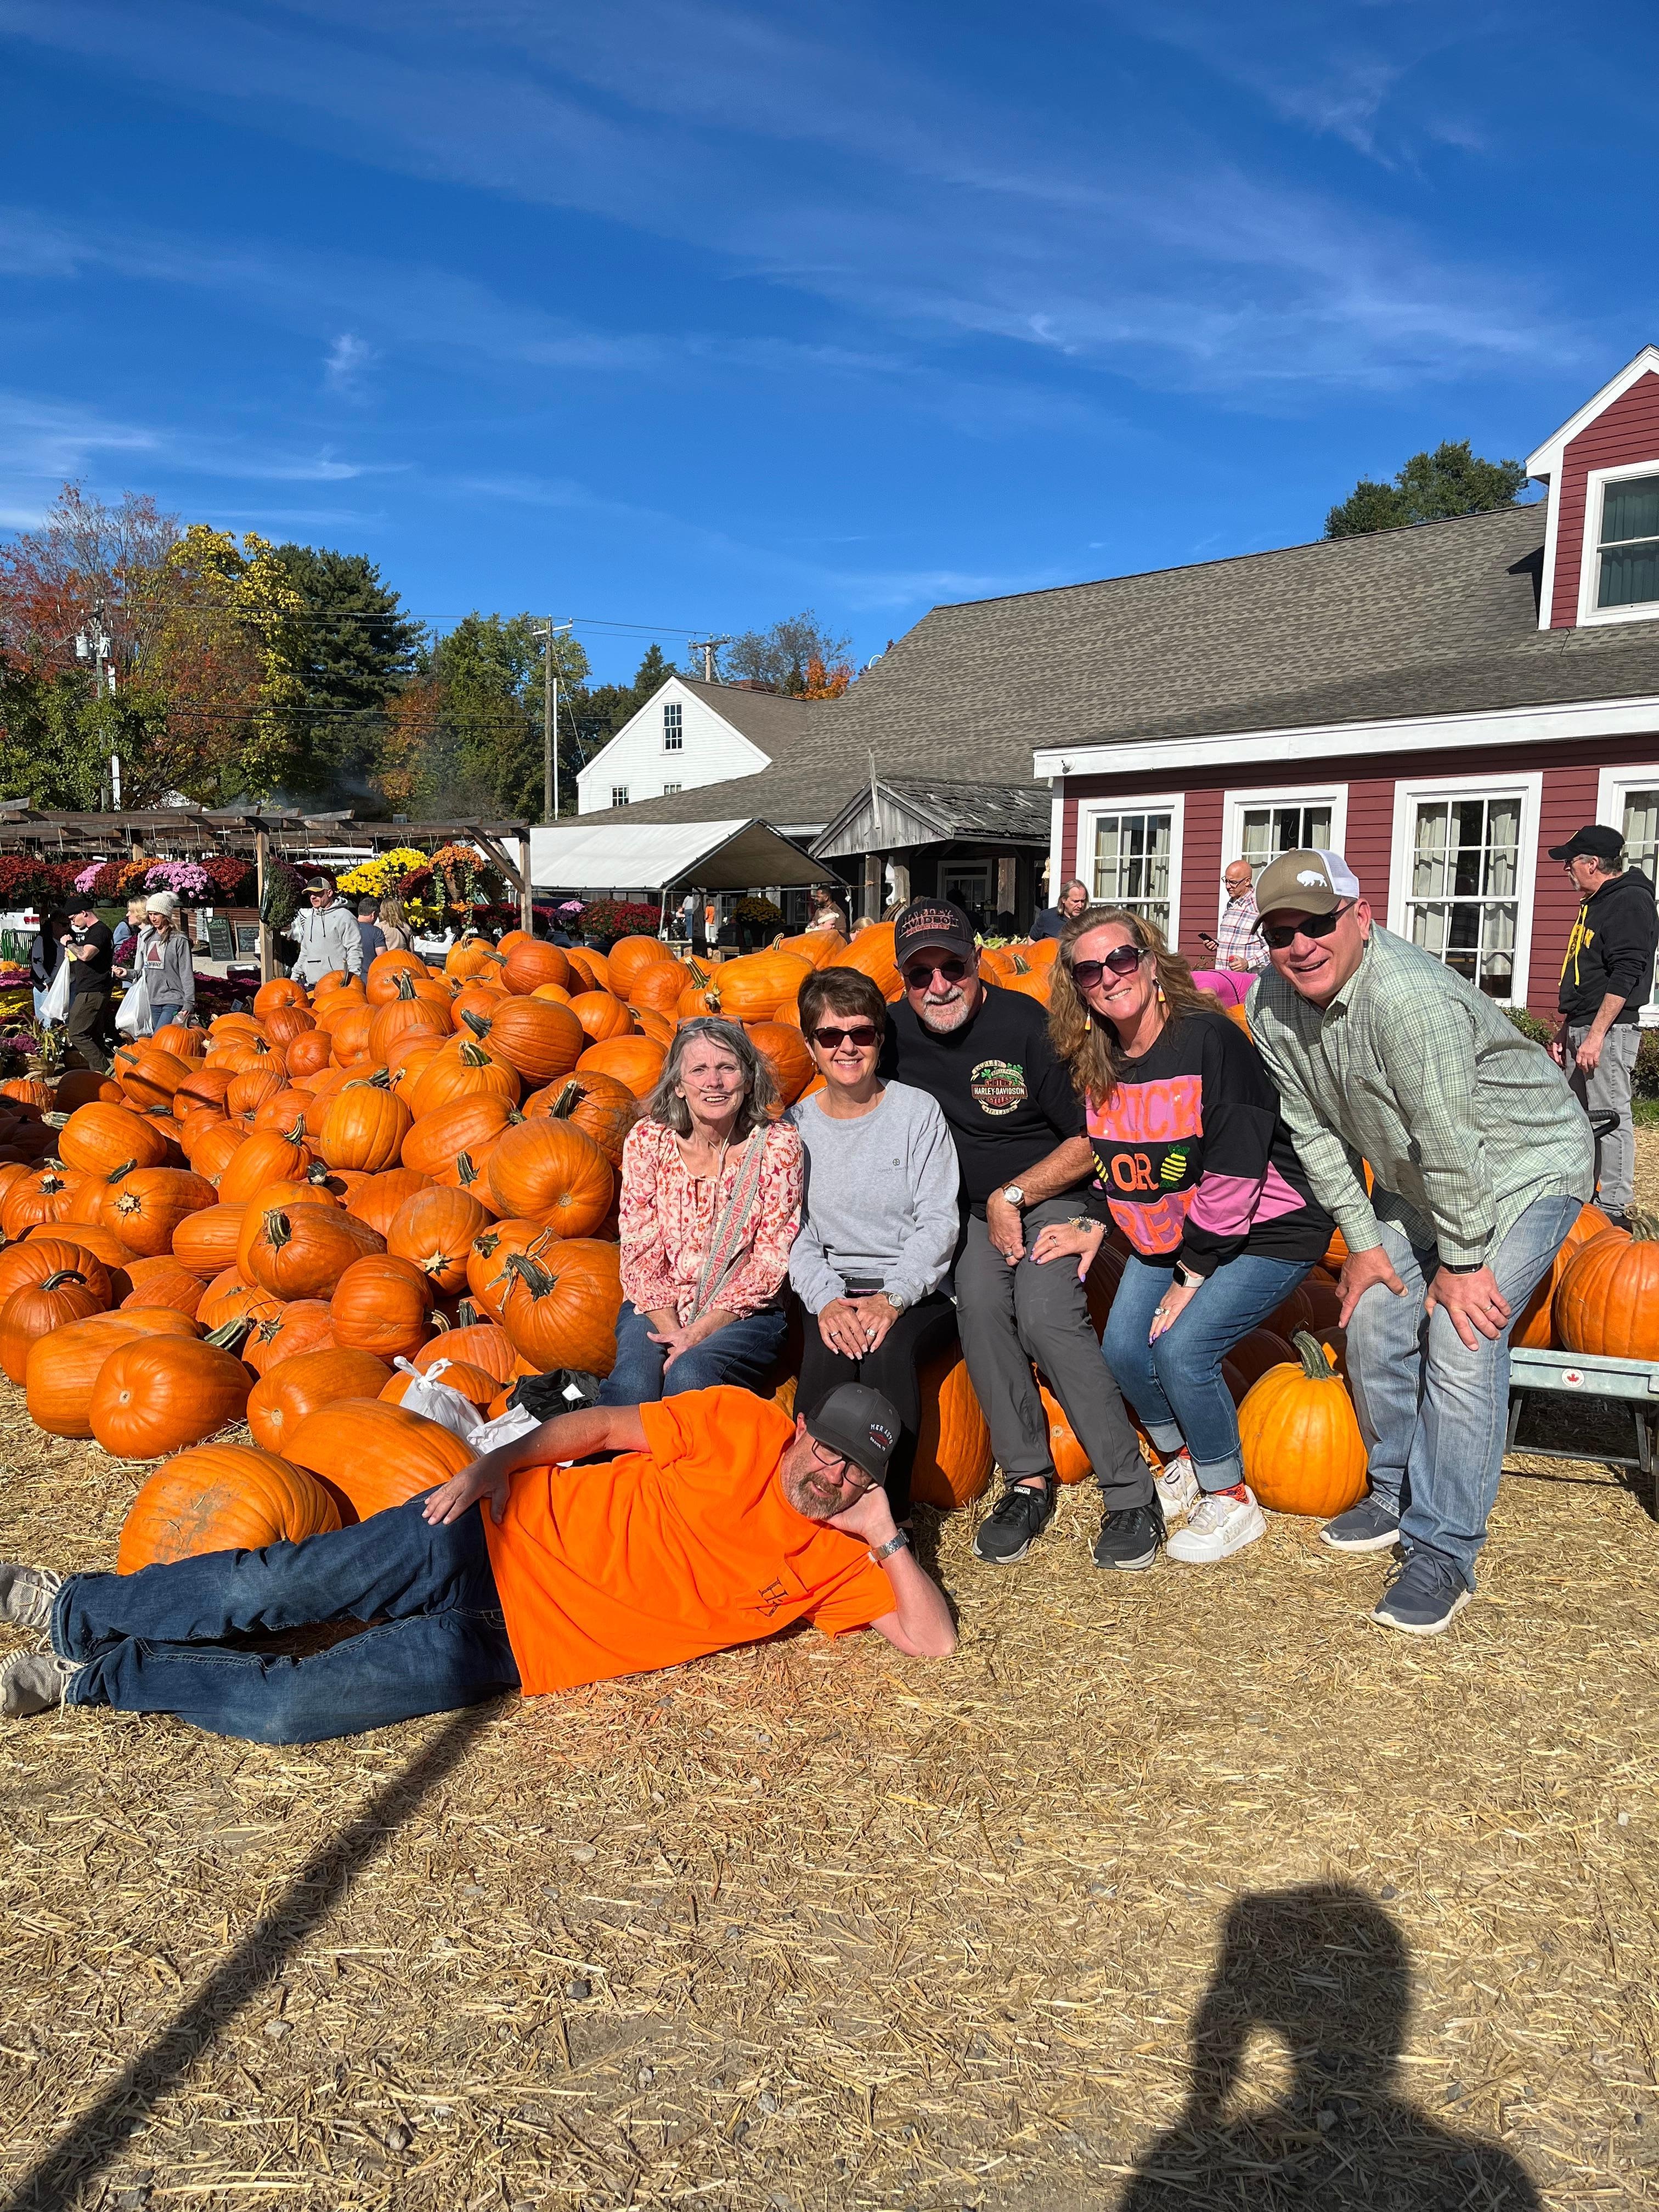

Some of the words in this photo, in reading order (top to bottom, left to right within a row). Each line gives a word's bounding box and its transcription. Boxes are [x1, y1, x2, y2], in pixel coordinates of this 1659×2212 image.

[974, 1087, 1025, 1095] HARLEY-DAVIDSON
[1085, 1080, 1204, 1140] RICK
[1111, 1153, 1159, 1192] OR
[884, 1429, 893, 1444] AUTO
